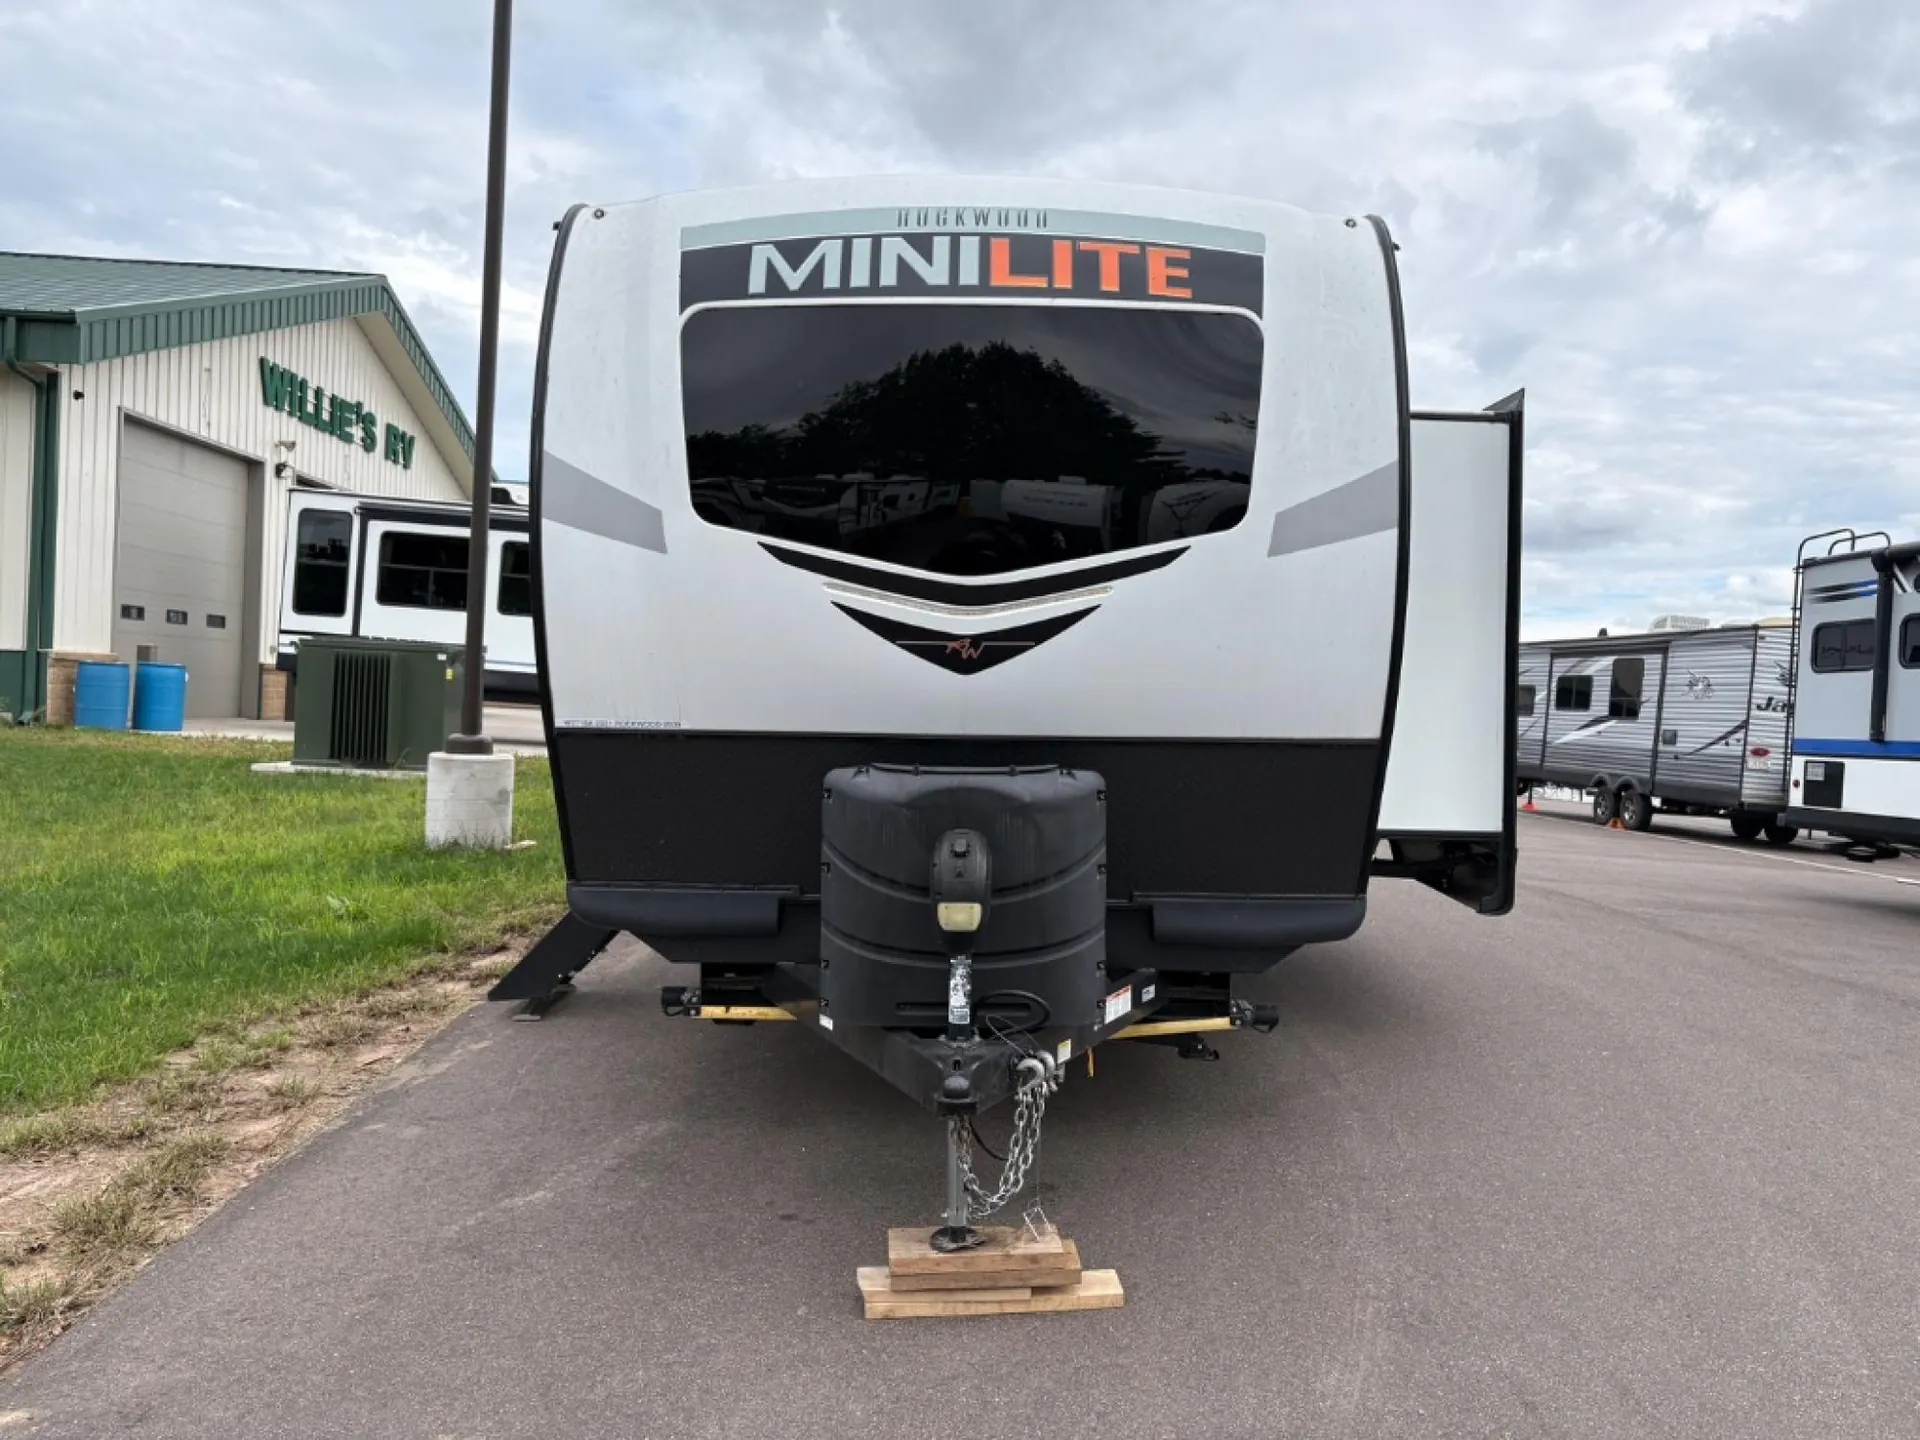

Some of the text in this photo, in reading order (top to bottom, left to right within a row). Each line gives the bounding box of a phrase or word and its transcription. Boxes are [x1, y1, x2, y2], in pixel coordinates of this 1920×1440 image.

[748, 236, 1193, 298] MINILITE
[260, 356, 416, 470] WILLIE'S RV
